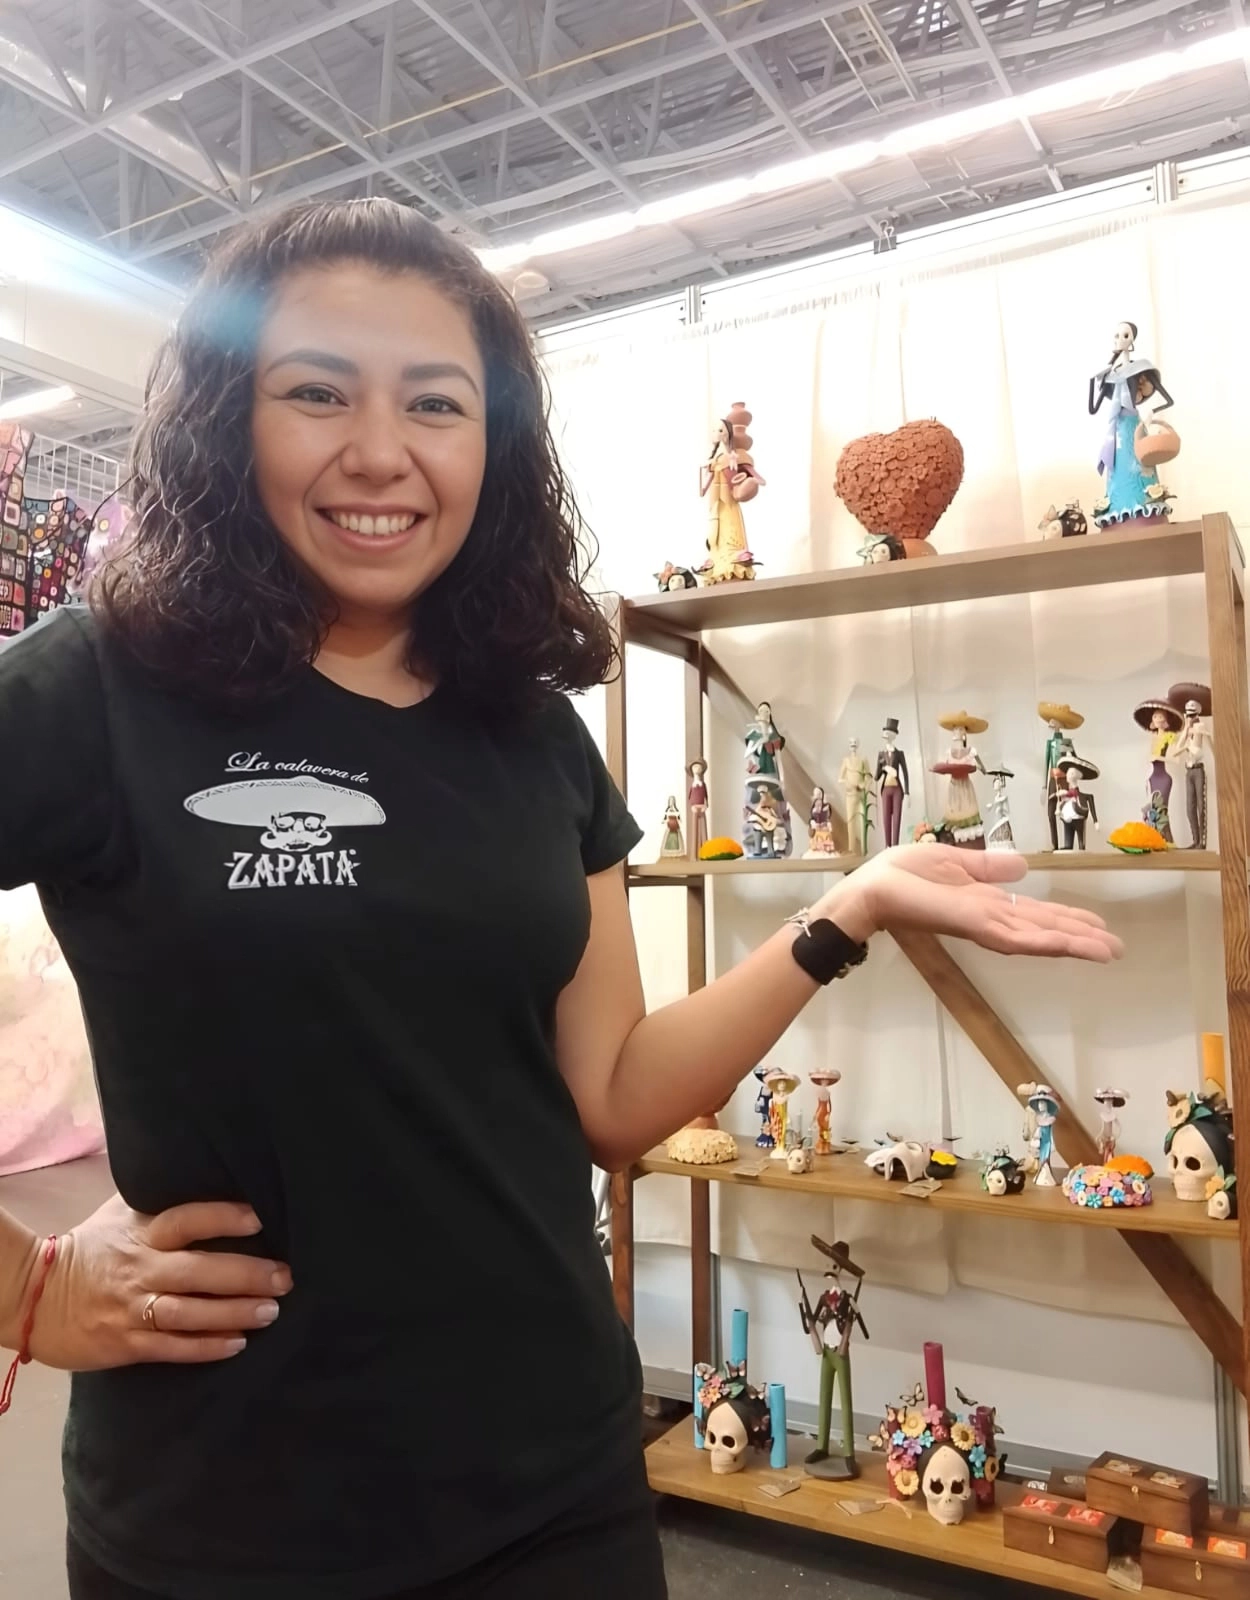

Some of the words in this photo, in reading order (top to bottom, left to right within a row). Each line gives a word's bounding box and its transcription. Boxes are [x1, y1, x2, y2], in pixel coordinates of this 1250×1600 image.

[224, 751, 270, 772] La
[275, 759, 349, 779] calavera
[350, 771, 370, 784] de
[225, 849, 360, 890] ZAPATA
